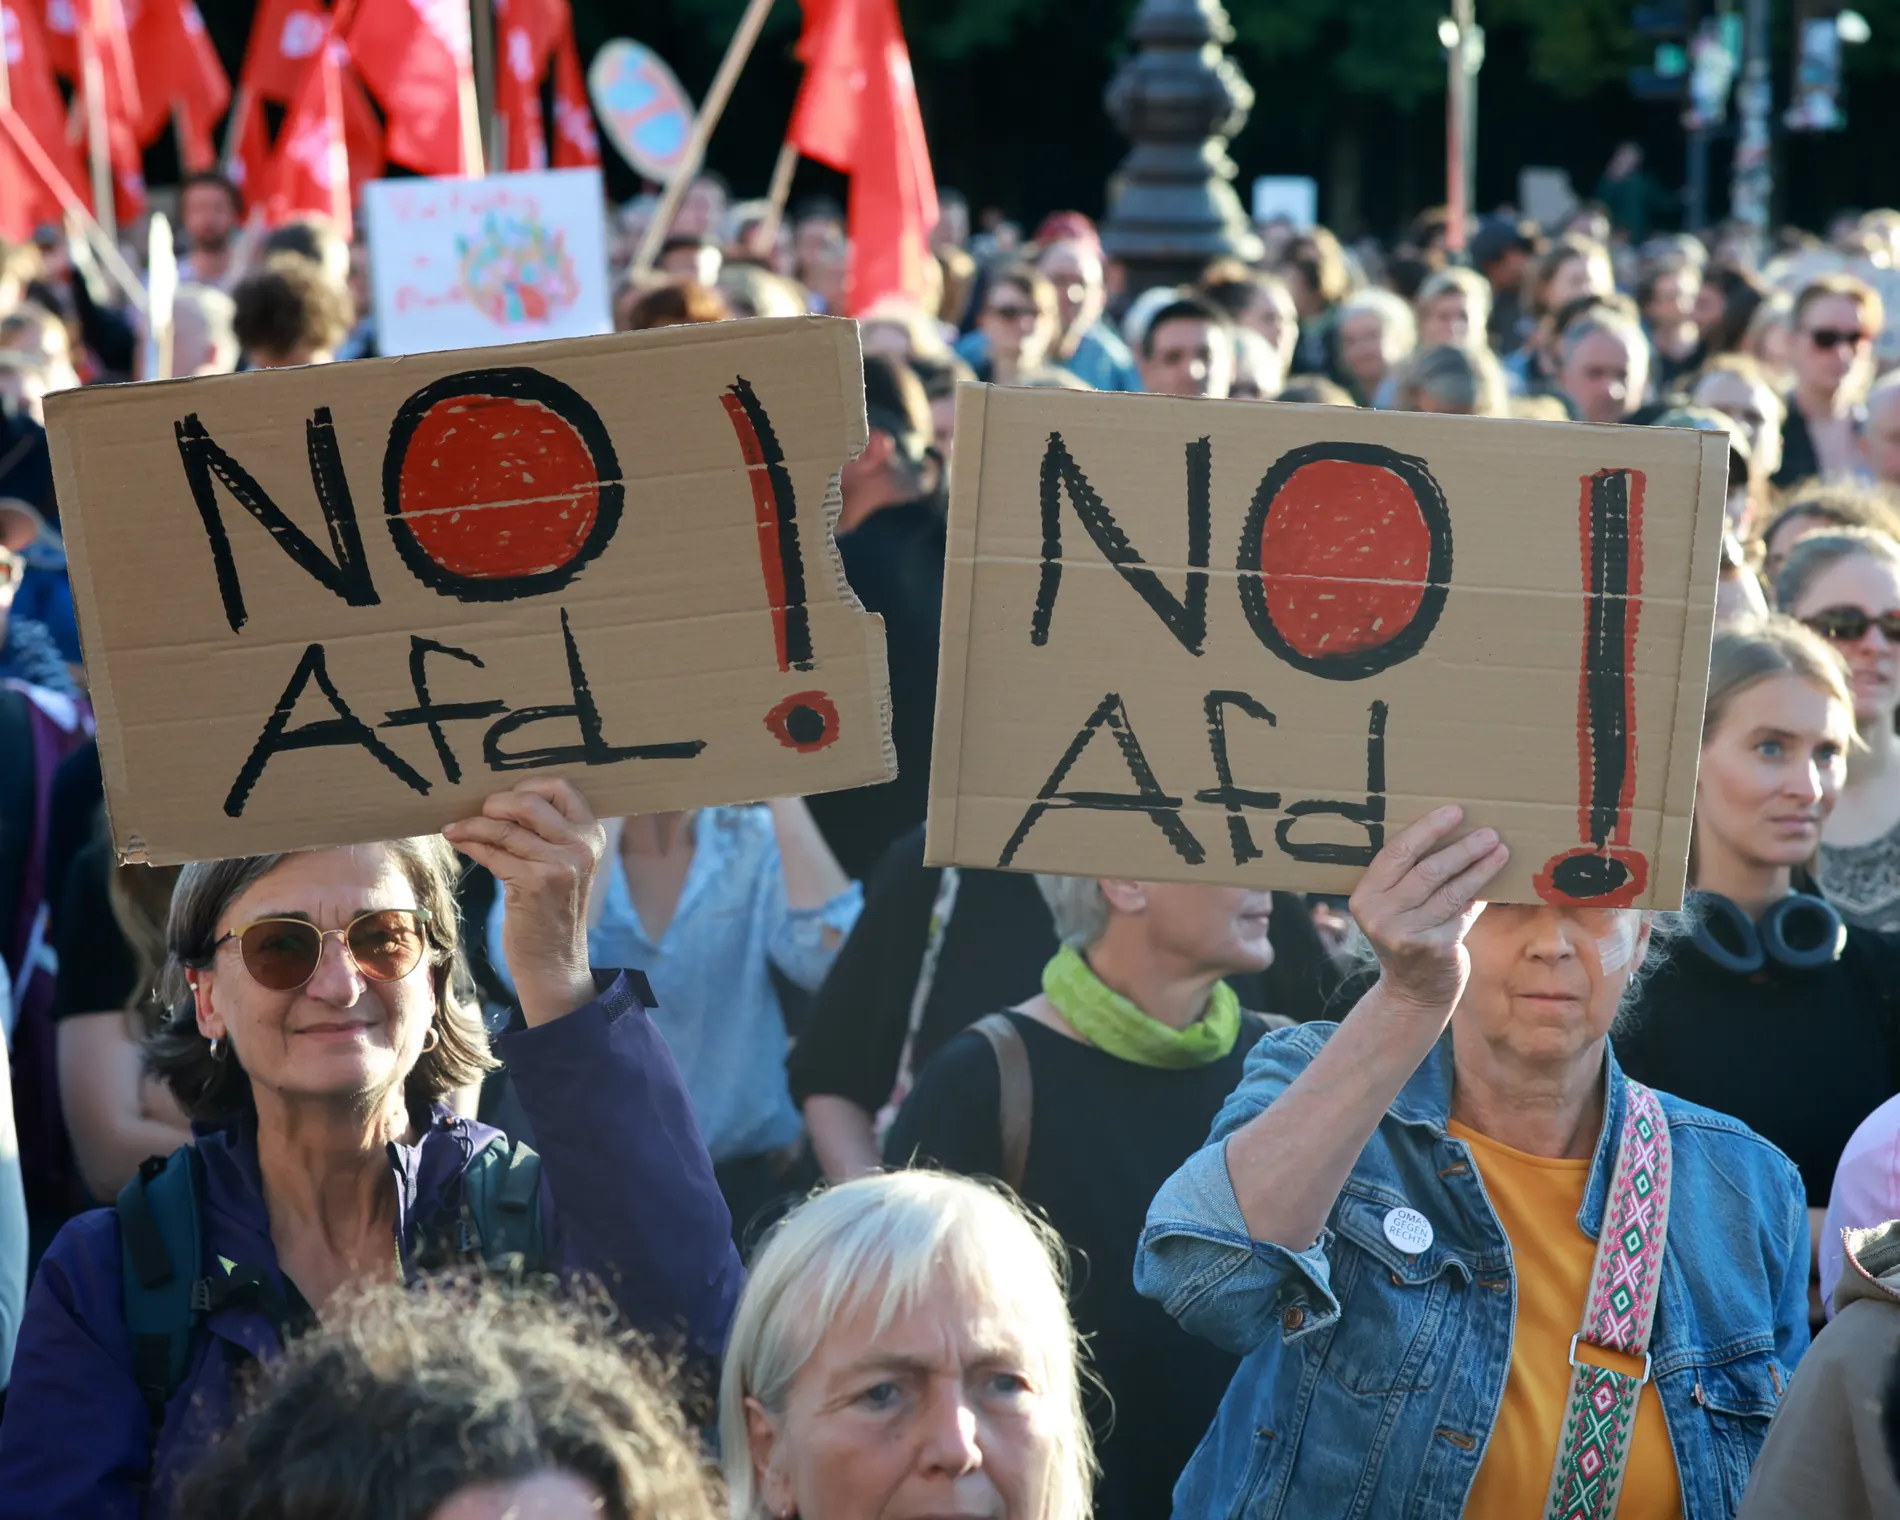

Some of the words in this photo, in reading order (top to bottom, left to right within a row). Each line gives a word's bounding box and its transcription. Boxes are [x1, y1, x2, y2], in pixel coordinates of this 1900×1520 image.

[174, 366, 625, 634] NO
[1030, 431, 1454, 681] NO
[1393, 1217, 1428, 1238] GEGEN
[1398, 1210, 1428, 1228] OMAS
[1389, 1225, 1427, 1248] RECHTS
